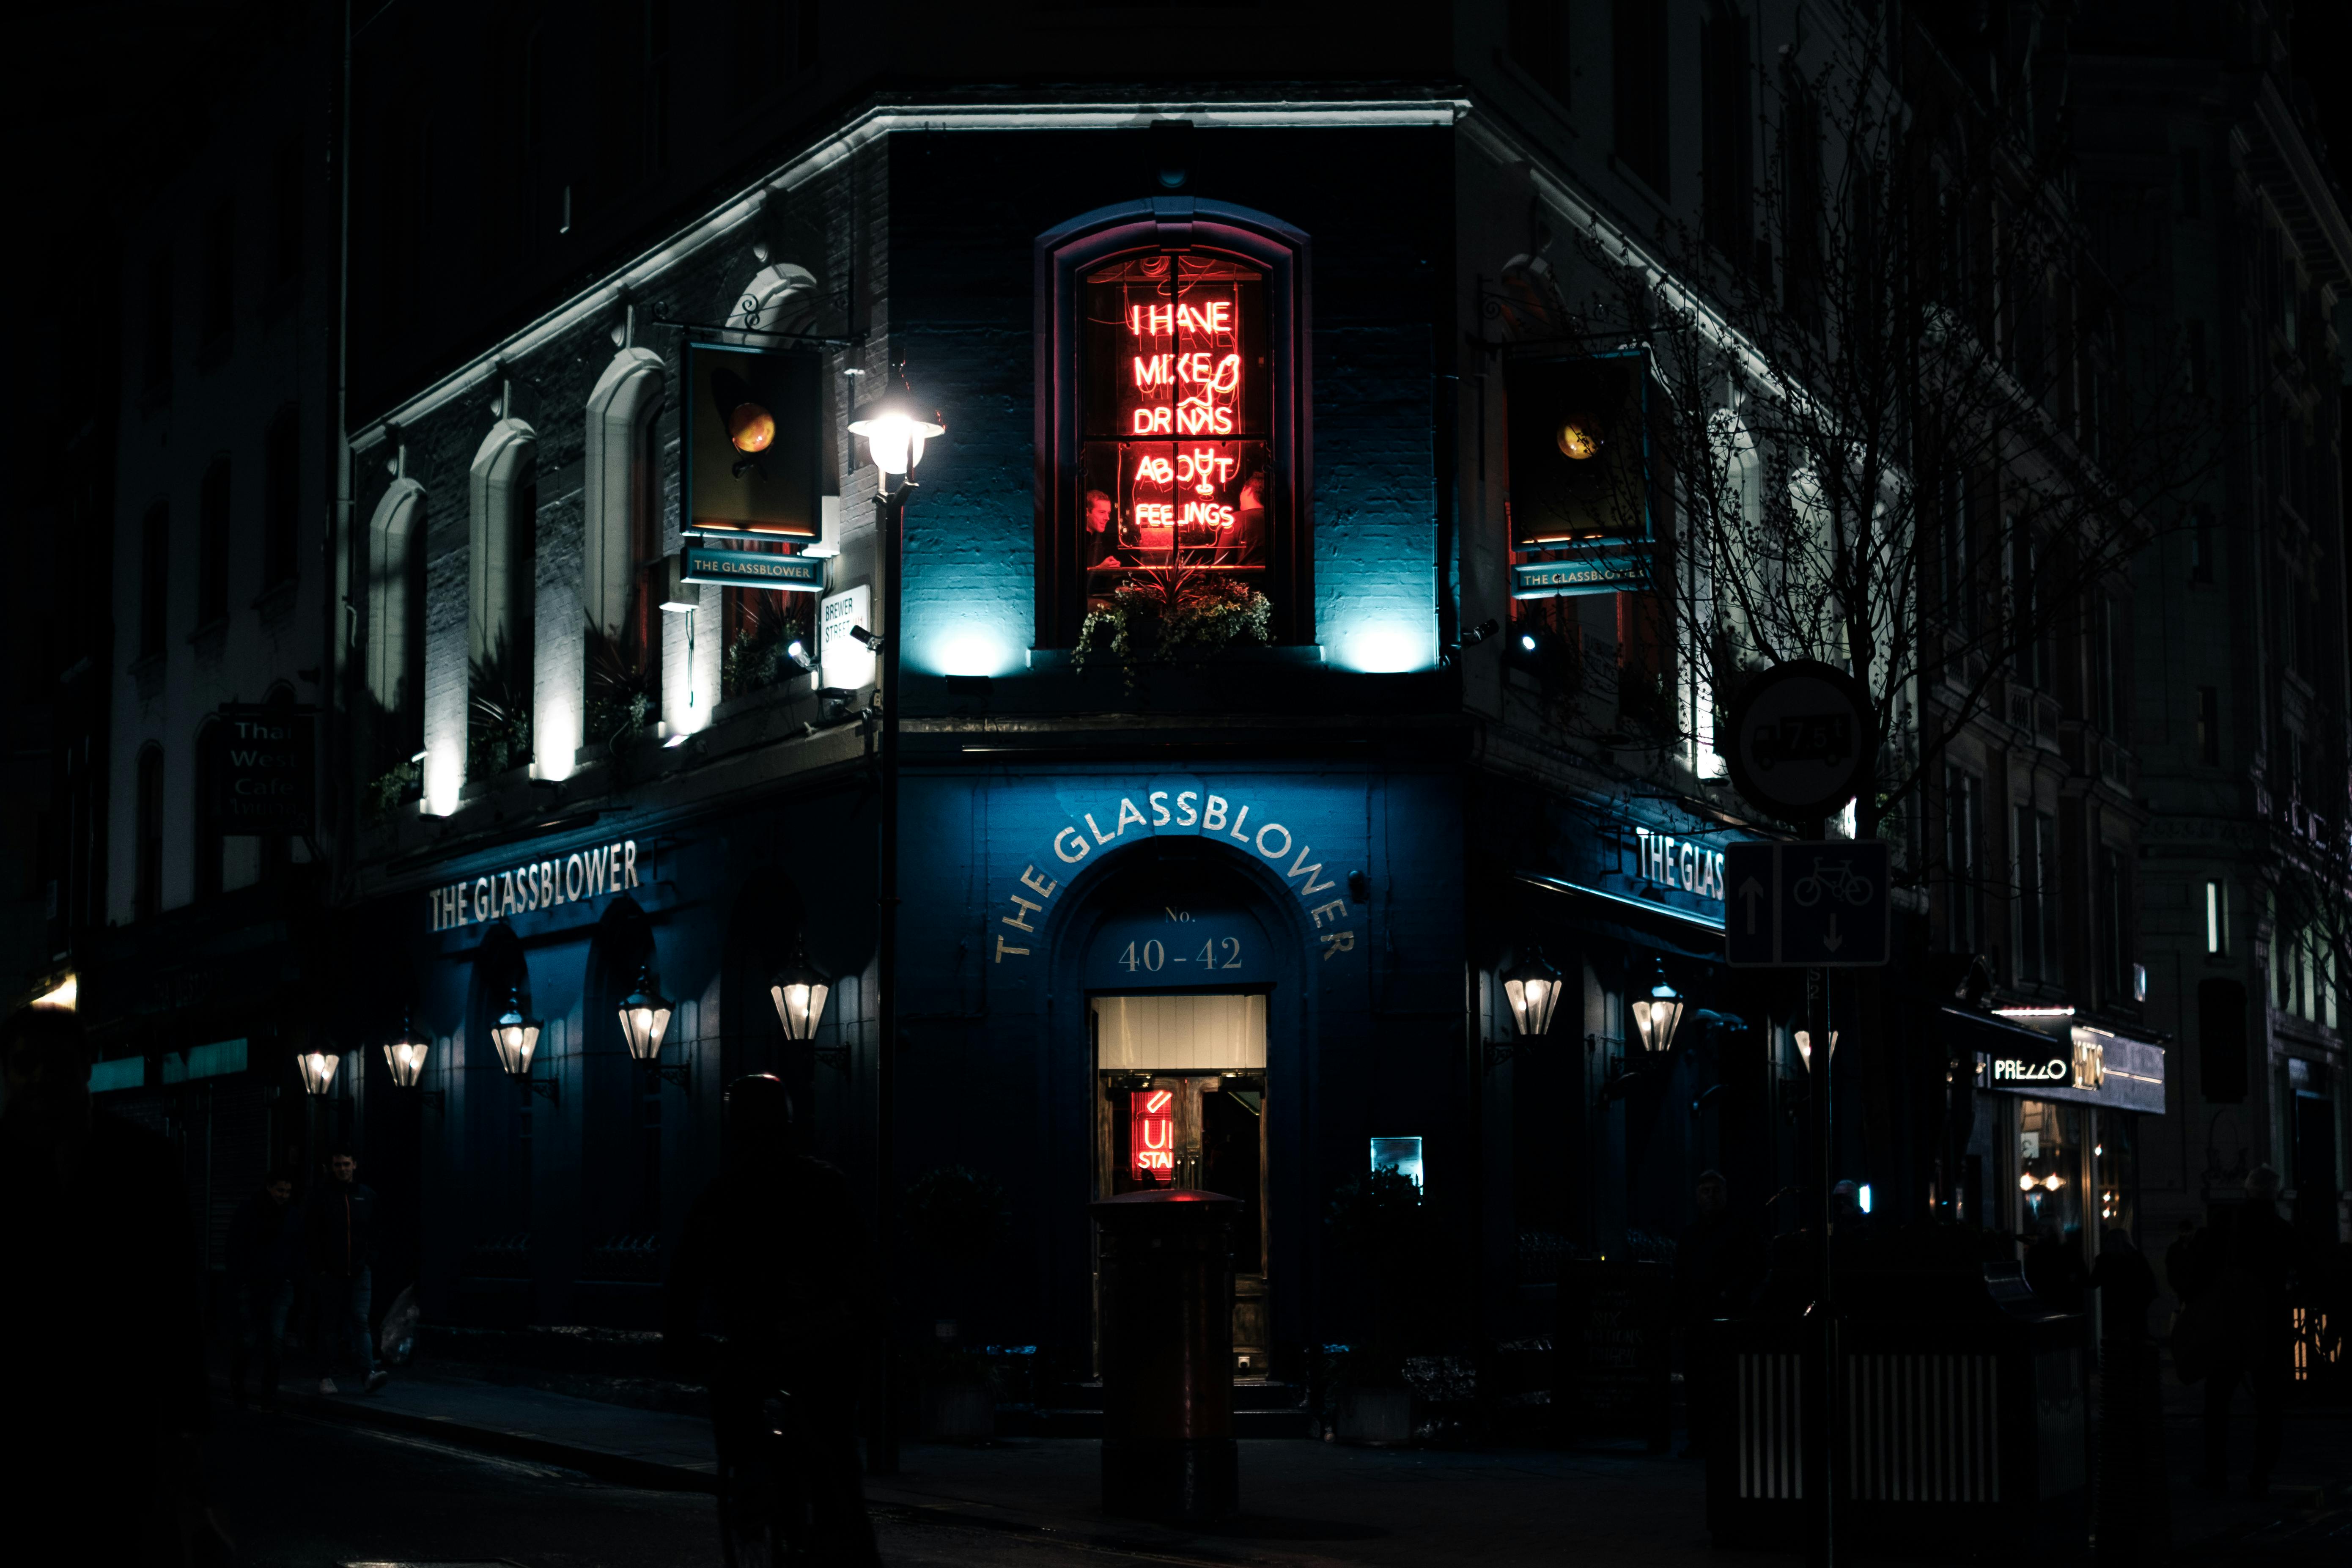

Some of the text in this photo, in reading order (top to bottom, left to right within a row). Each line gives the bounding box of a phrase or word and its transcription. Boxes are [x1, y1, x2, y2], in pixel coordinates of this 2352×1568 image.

[1133, 302, 1232, 336] I HAVE
[1134, 406, 1232, 435] DRNKS
[694, 559, 811, 578] THE GLASSBLOWER
[1524, 574, 1548, 586] THE
[825, 598, 854, 622] BREWER
[825, 620, 850, 643] STREET
[234, 721, 292, 740] Thai
[230, 750, 299, 768] West
[234, 778, 295, 796] Cafe
[1636, 826, 1675, 887] THE
[430, 839, 639, 932] THE GLASSBLOWER
[995, 791, 1356, 964] THE GLASSBLOWER
[1165, 906, 1196, 923] No.
